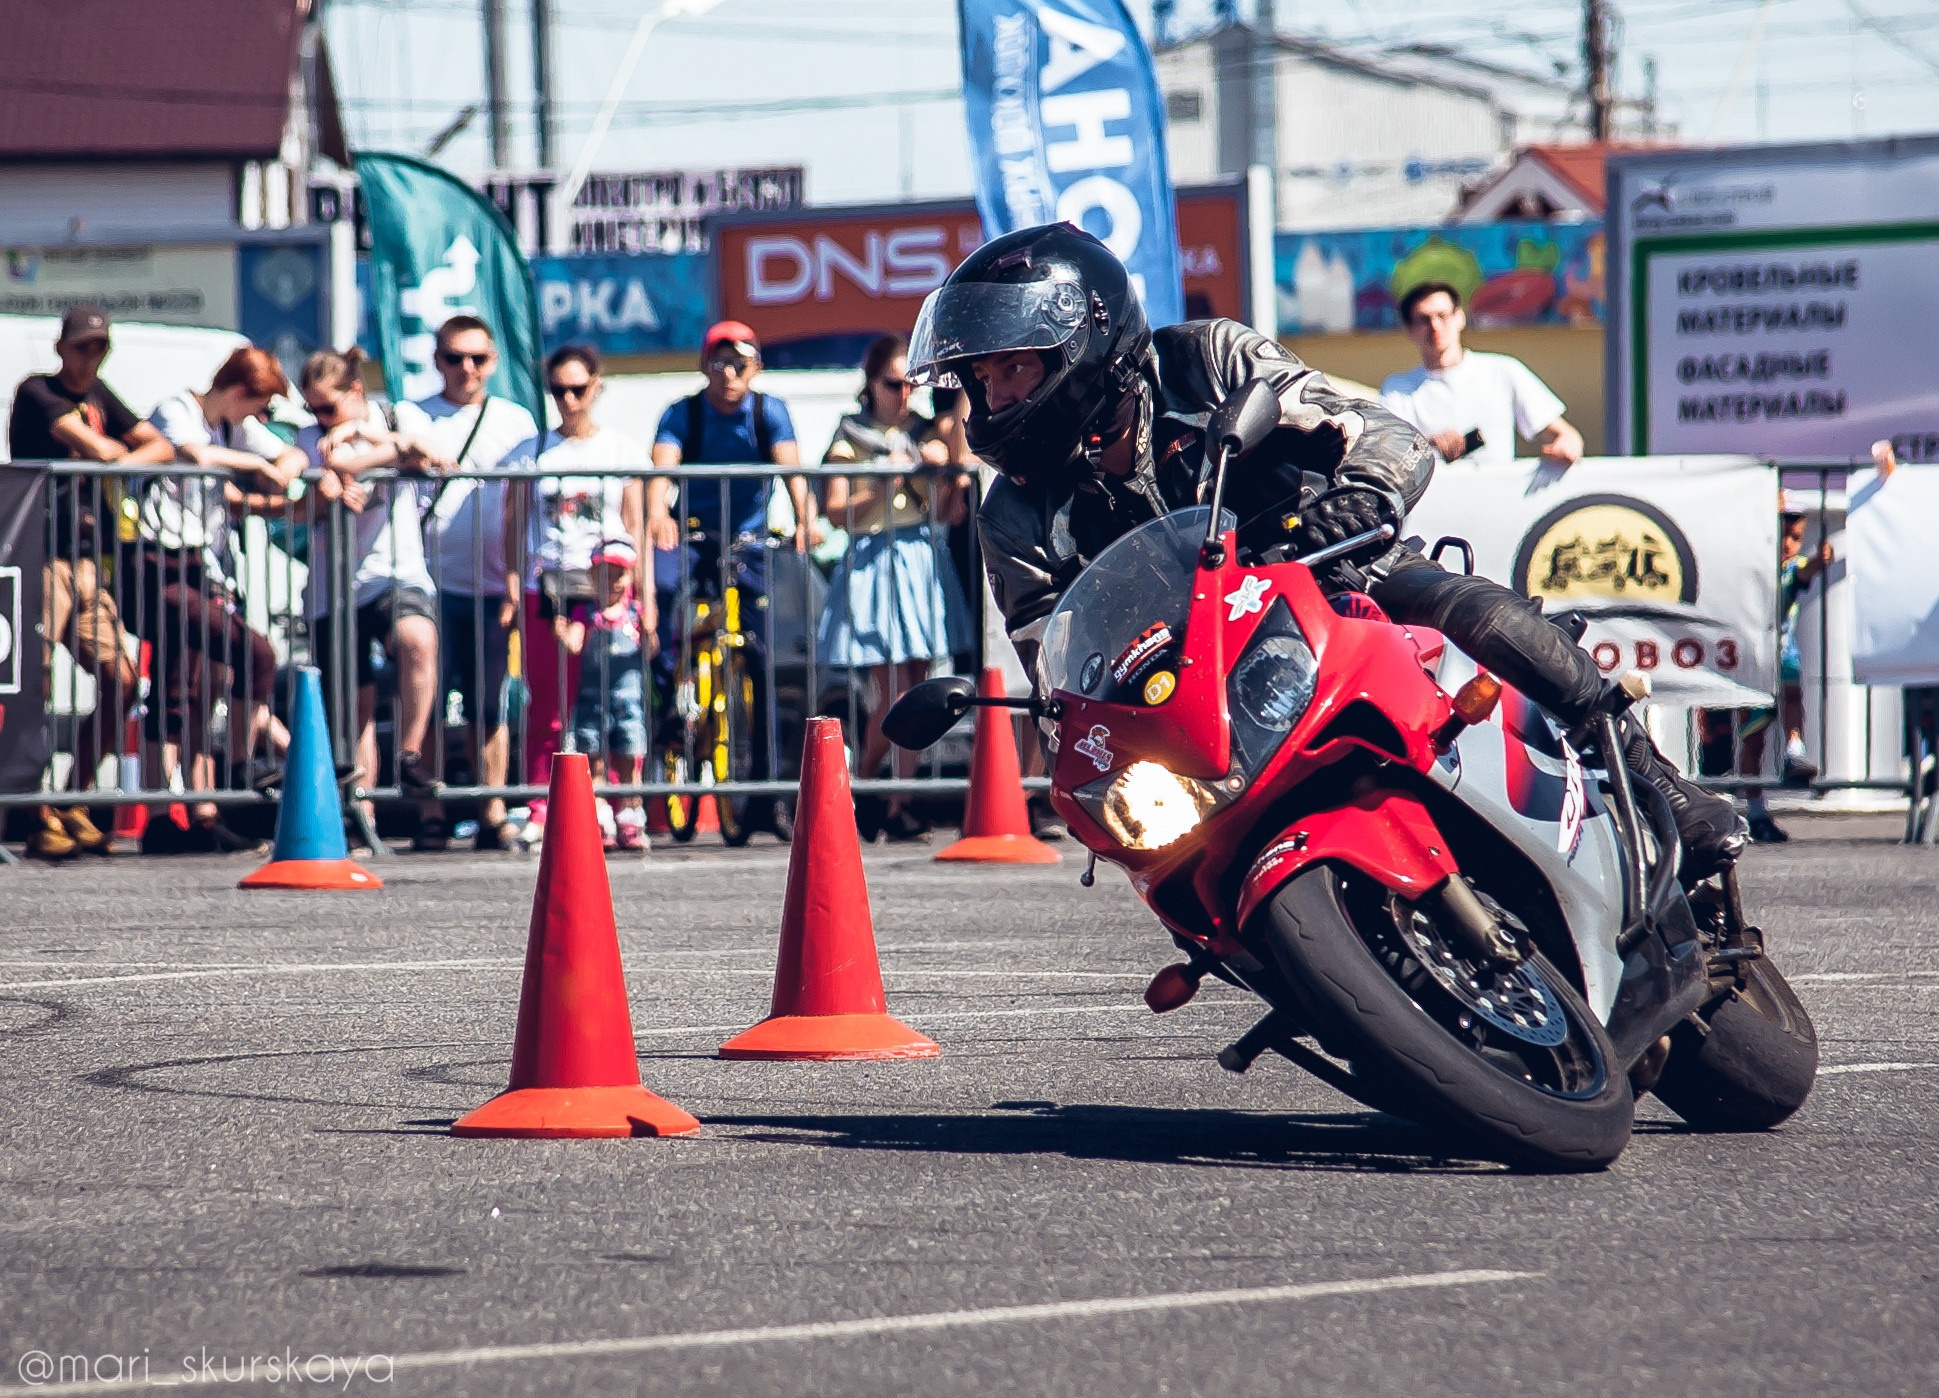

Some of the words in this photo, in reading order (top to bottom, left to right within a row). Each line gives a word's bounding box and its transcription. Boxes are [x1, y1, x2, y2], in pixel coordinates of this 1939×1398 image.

[1037, 5, 1146, 302] АНО
[747, 228, 949, 302] DNS
[1678, 261, 1858, 296] КРОВЕЛЬНЫЕ
[542, 279, 660, 331] РКА
[1677, 303, 1846, 335] МАТЕРИАЛЫ
[1677, 350, 1830, 384] ФАСАДНЫЕ
[1678, 389, 1847, 422] МАТЕРИАЛЫ
[1113, 627, 1171, 683] gymkhana
[1127, 648, 1168, 685] HONDA
[1592, 637, 1738, 671] ОВОЗ
